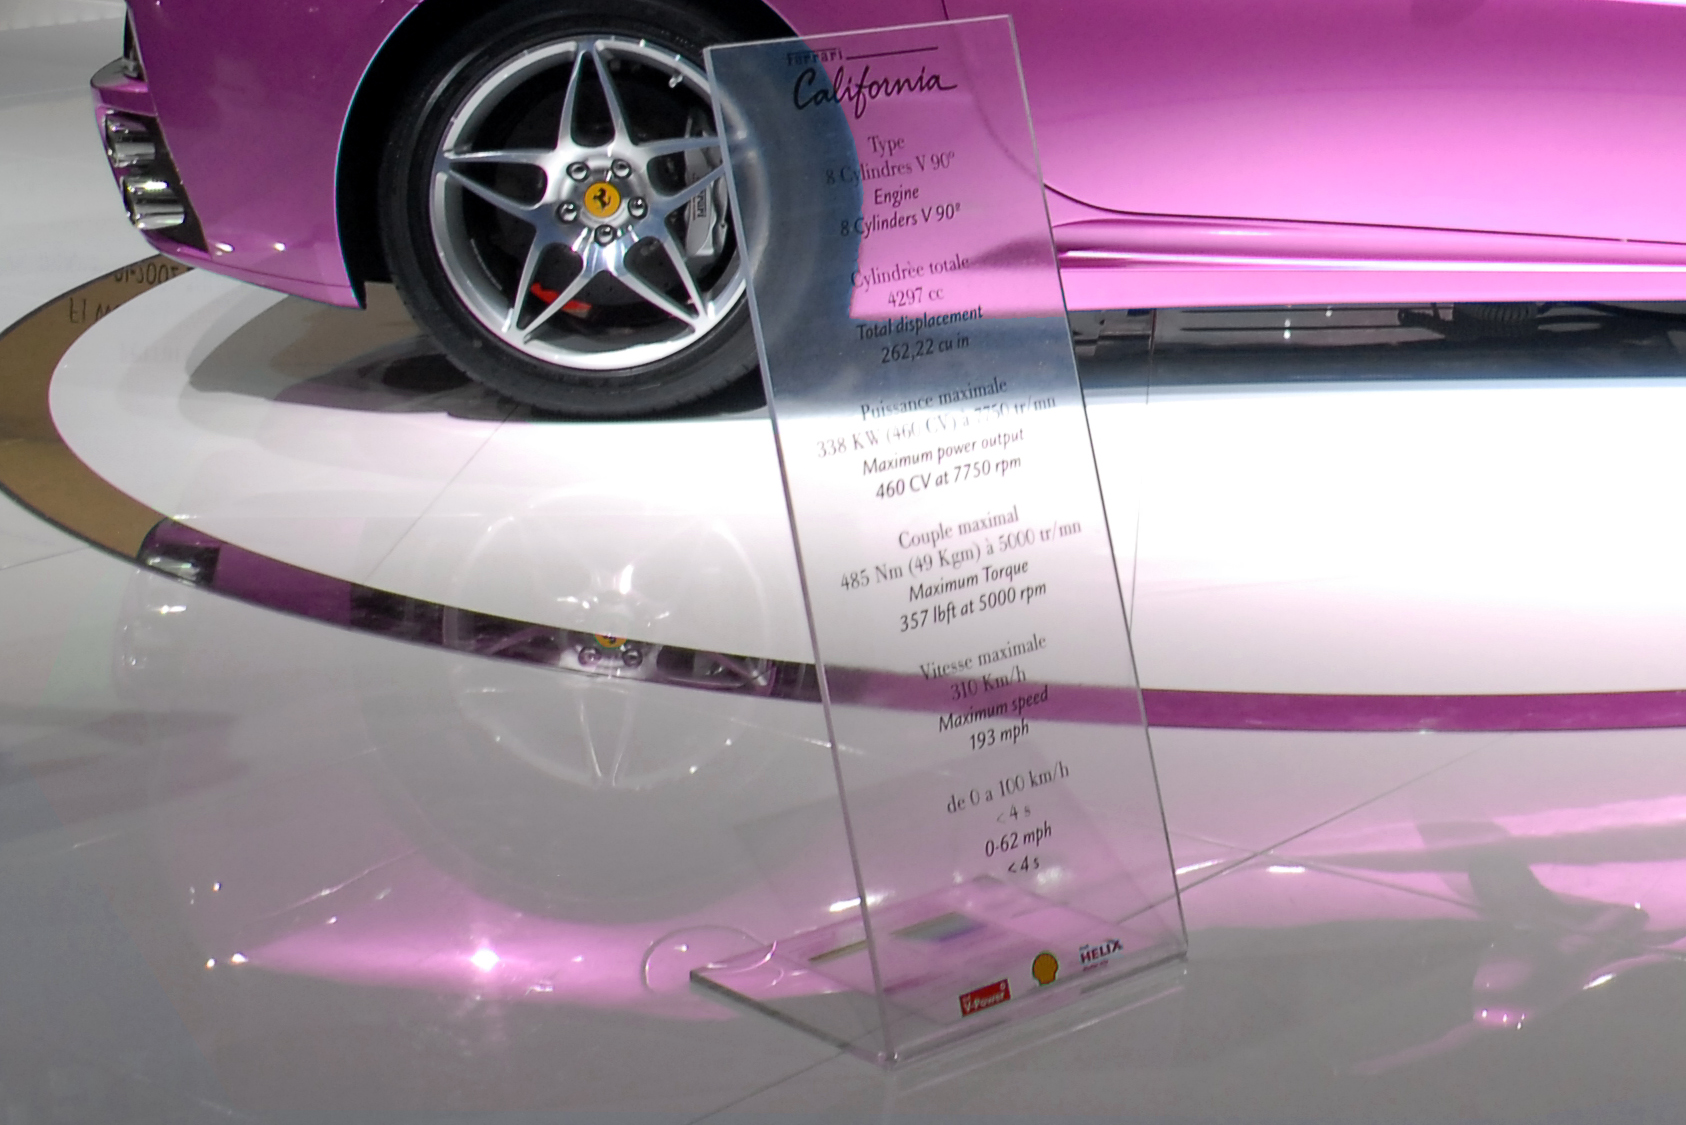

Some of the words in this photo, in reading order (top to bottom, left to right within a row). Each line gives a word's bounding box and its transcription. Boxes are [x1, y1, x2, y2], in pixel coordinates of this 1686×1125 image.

[793, 65, 958, 120] California
[867, 135, 906, 157] Type
[825, 169, 835, 185] 8
[840, 159, 912, 188] Cylindres
[915, 154, 927, 173] V
[873, 184, 920, 208] Engine
[840, 219, 849, 237] 8
[853, 211, 919, 238] Cylinders
[921, 206, 935, 224] V
[928, 253, 970, 275] totale
[887, 286, 924, 309] 4297
[928, 286, 945, 302] cc
[856, 317, 893, 342] Total
[895, 304, 984, 337] displacement
[881, 337, 935, 365] 262,22
[938, 338, 953, 354] cu
[956, 335, 970, 351] in
[860, 393, 934, 422] Puissance
[938, 377, 1008, 405] maximale
[816, 439, 847, 459] 338
[1014, 395, 1057, 417] tr/mn
[862, 449, 934, 477] Maximum
[937, 439, 977, 466] power
[981, 427, 1025, 453] output
[875, 478, 906, 500] 460
[909, 473, 933, 491] CV
[935, 470, 950, 487] at
[953, 461, 992, 483] 7750
[995, 456, 1022, 476] rpm
[898, 521, 953, 551] Couple
[958, 504, 1020, 535] maximal
[840, 571, 870, 592] 485
[874, 563, 903, 584] Nm
[908, 554, 934, 577] (49
[938, 542, 981, 570] Kgm)
[986, 538, 995, 556] à
[998, 529, 1036, 553] 5000
[1039, 519, 1082, 543] tr/mn
[908, 574, 979, 603] Maximum
[982, 559, 1029, 587] Torque
[900, 609, 929, 633] 357
[933, 602, 957, 625] lbft
[960, 601, 975, 617] at
[979, 589, 1017, 613] 5000
[1020, 582, 1047, 605] rpm
[919, 655, 973, 682] Vitesse
[978, 633, 1047, 666] maximale
[950, 681, 979, 702] 310
[982, 664, 1027, 692] Km/h
[938, 702, 1008, 733] Maximum
[1011, 684, 1049, 713] speed
[969, 729, 996, 752] 193
[1000, 718, 1030, 743] mph
[946, 793, 966, 814] de
[969, 788, 981, 807] 0
[984, 788, 994, 803] a
[999, 775, 1026, 799] 100
[1029, 760, 1070, 789] km/h
[1009, 804, 1019, 821] 4
[1023, 806, 1032, 819] s
[984, 831, 1019, 858] 0-62
[1022, 820, 1053, 847] mph
[1020, 855, 1030, 872] 4
[1033, 856, 1041, 870] s
[1080, 939, 1123, 964] HELIX
